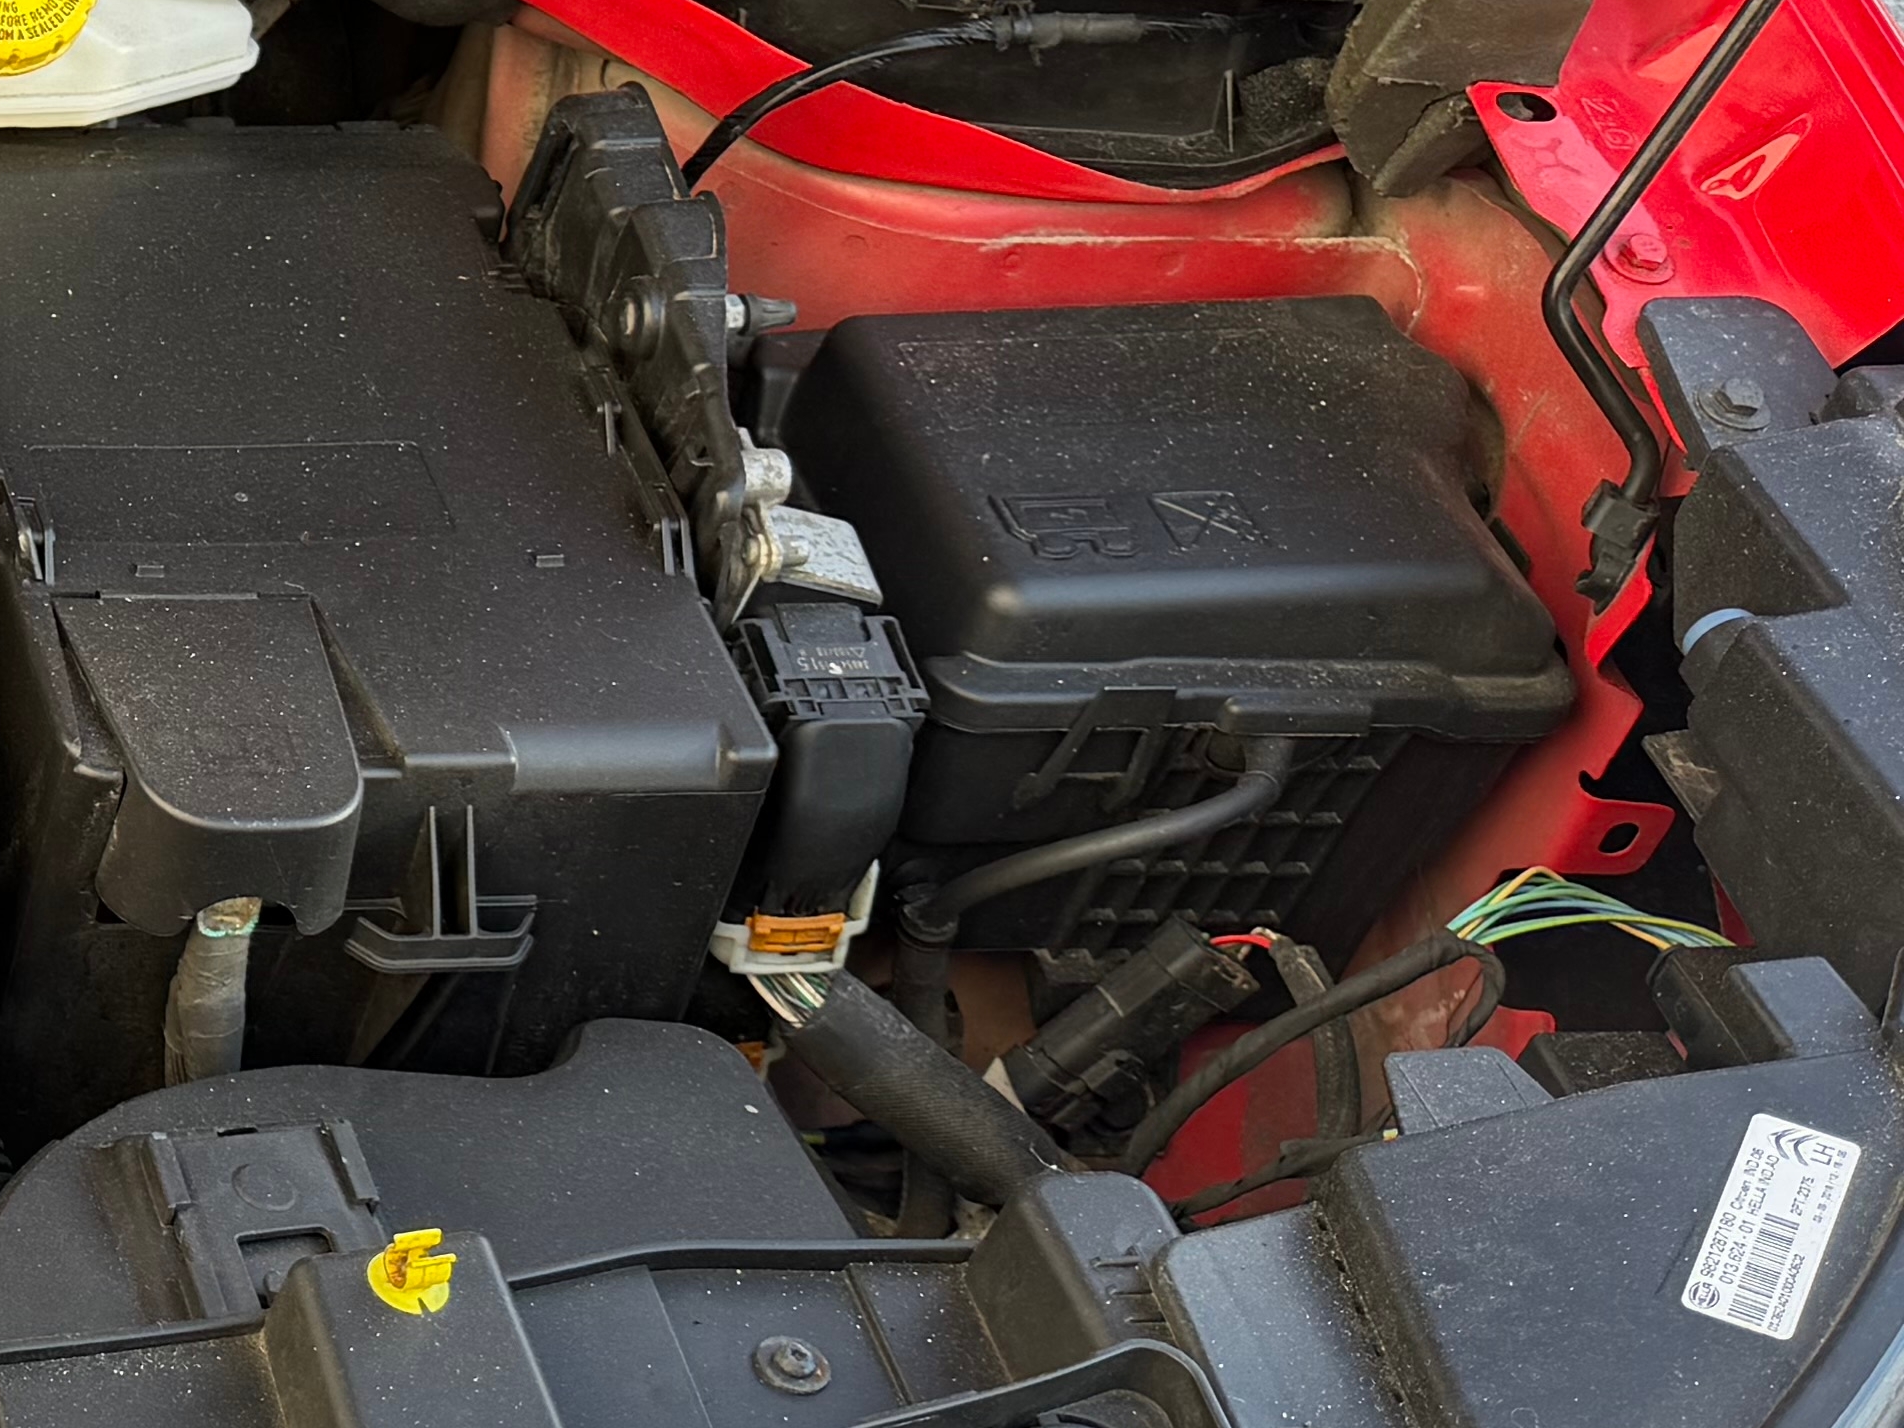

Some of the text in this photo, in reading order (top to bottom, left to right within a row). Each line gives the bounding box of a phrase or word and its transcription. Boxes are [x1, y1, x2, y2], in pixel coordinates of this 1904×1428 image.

[17, 29, 25, 40] A
[27, 11, 65, 39] SEALED
[1809, 1142, 1836, 1166] LH
[1699, 1212, 1736, 1278] 9821287180
